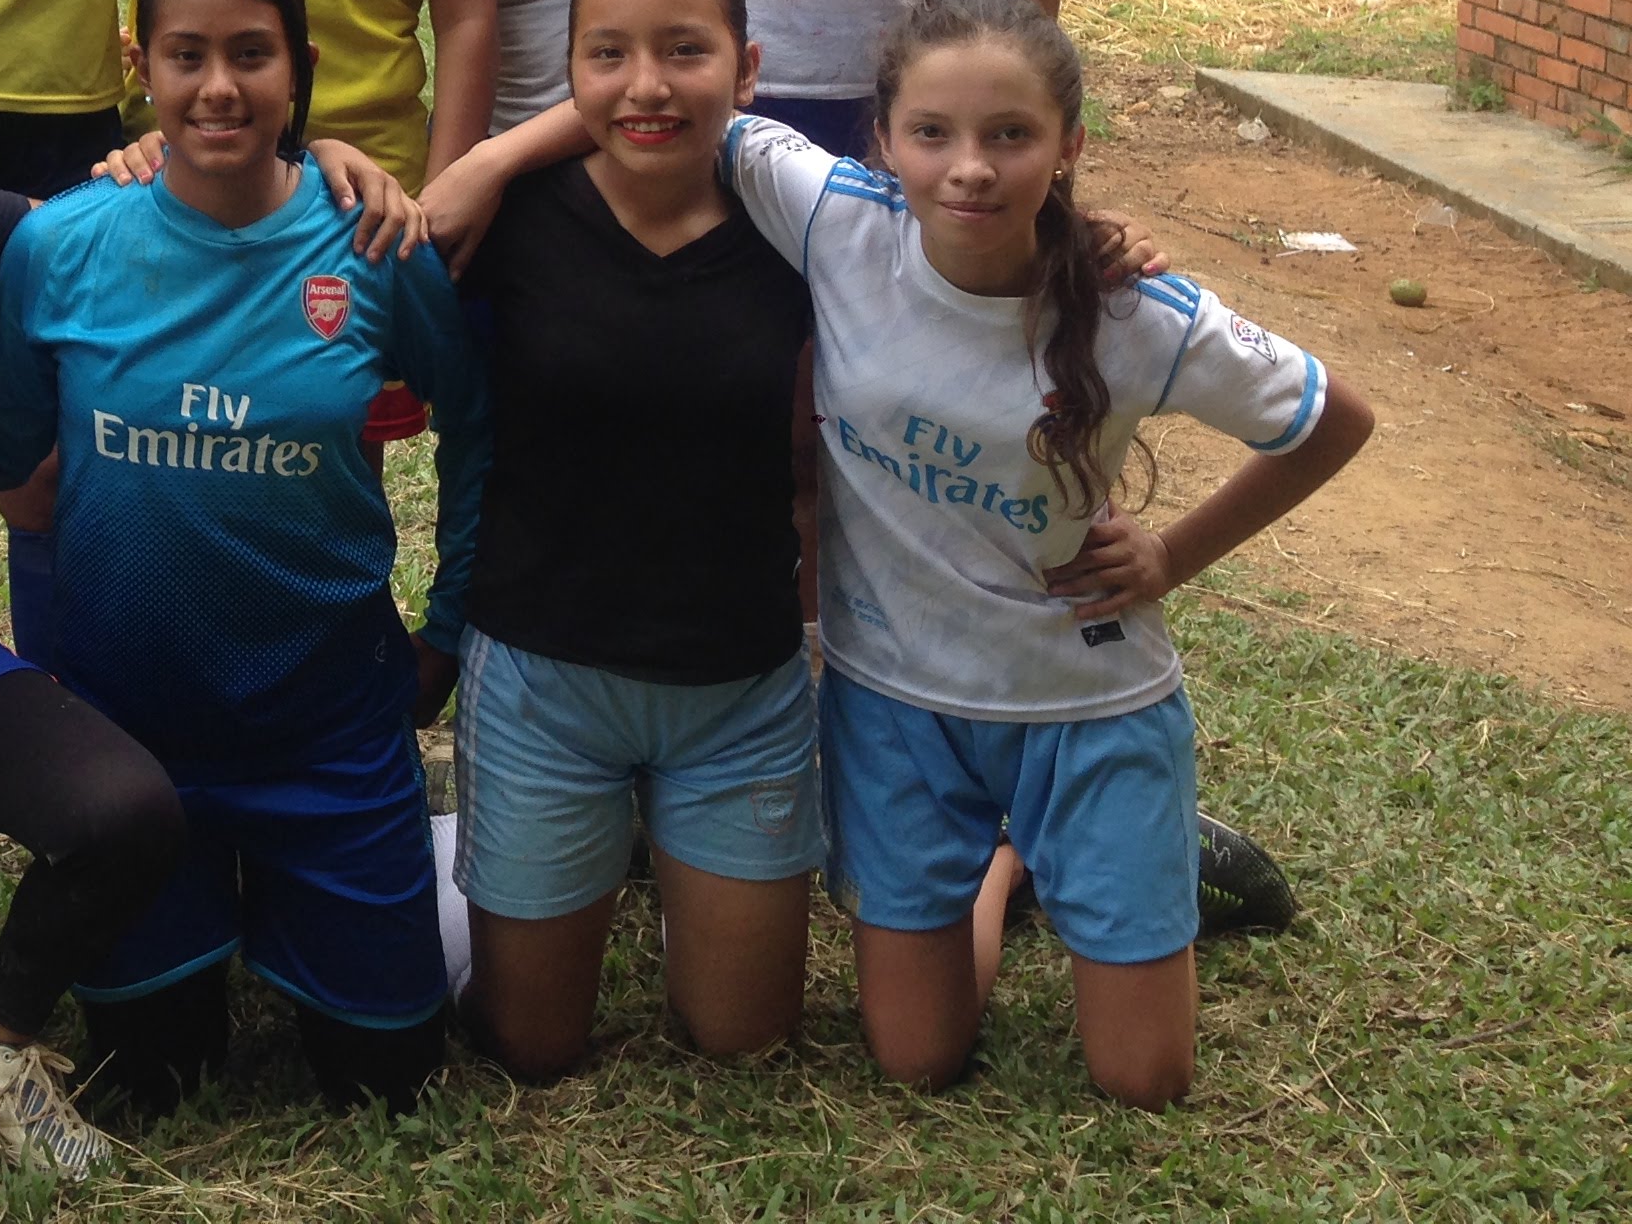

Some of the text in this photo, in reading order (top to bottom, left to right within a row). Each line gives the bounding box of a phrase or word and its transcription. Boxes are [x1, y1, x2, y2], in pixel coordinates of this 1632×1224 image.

[309, 283, 346, 295] Arsenal
[179, 382, 251, 429] Fly
[93, 409, 323, 477] Emirates
[903, 415, 982, 467] Fly
[837, 415, 1049, 534] Emirates
